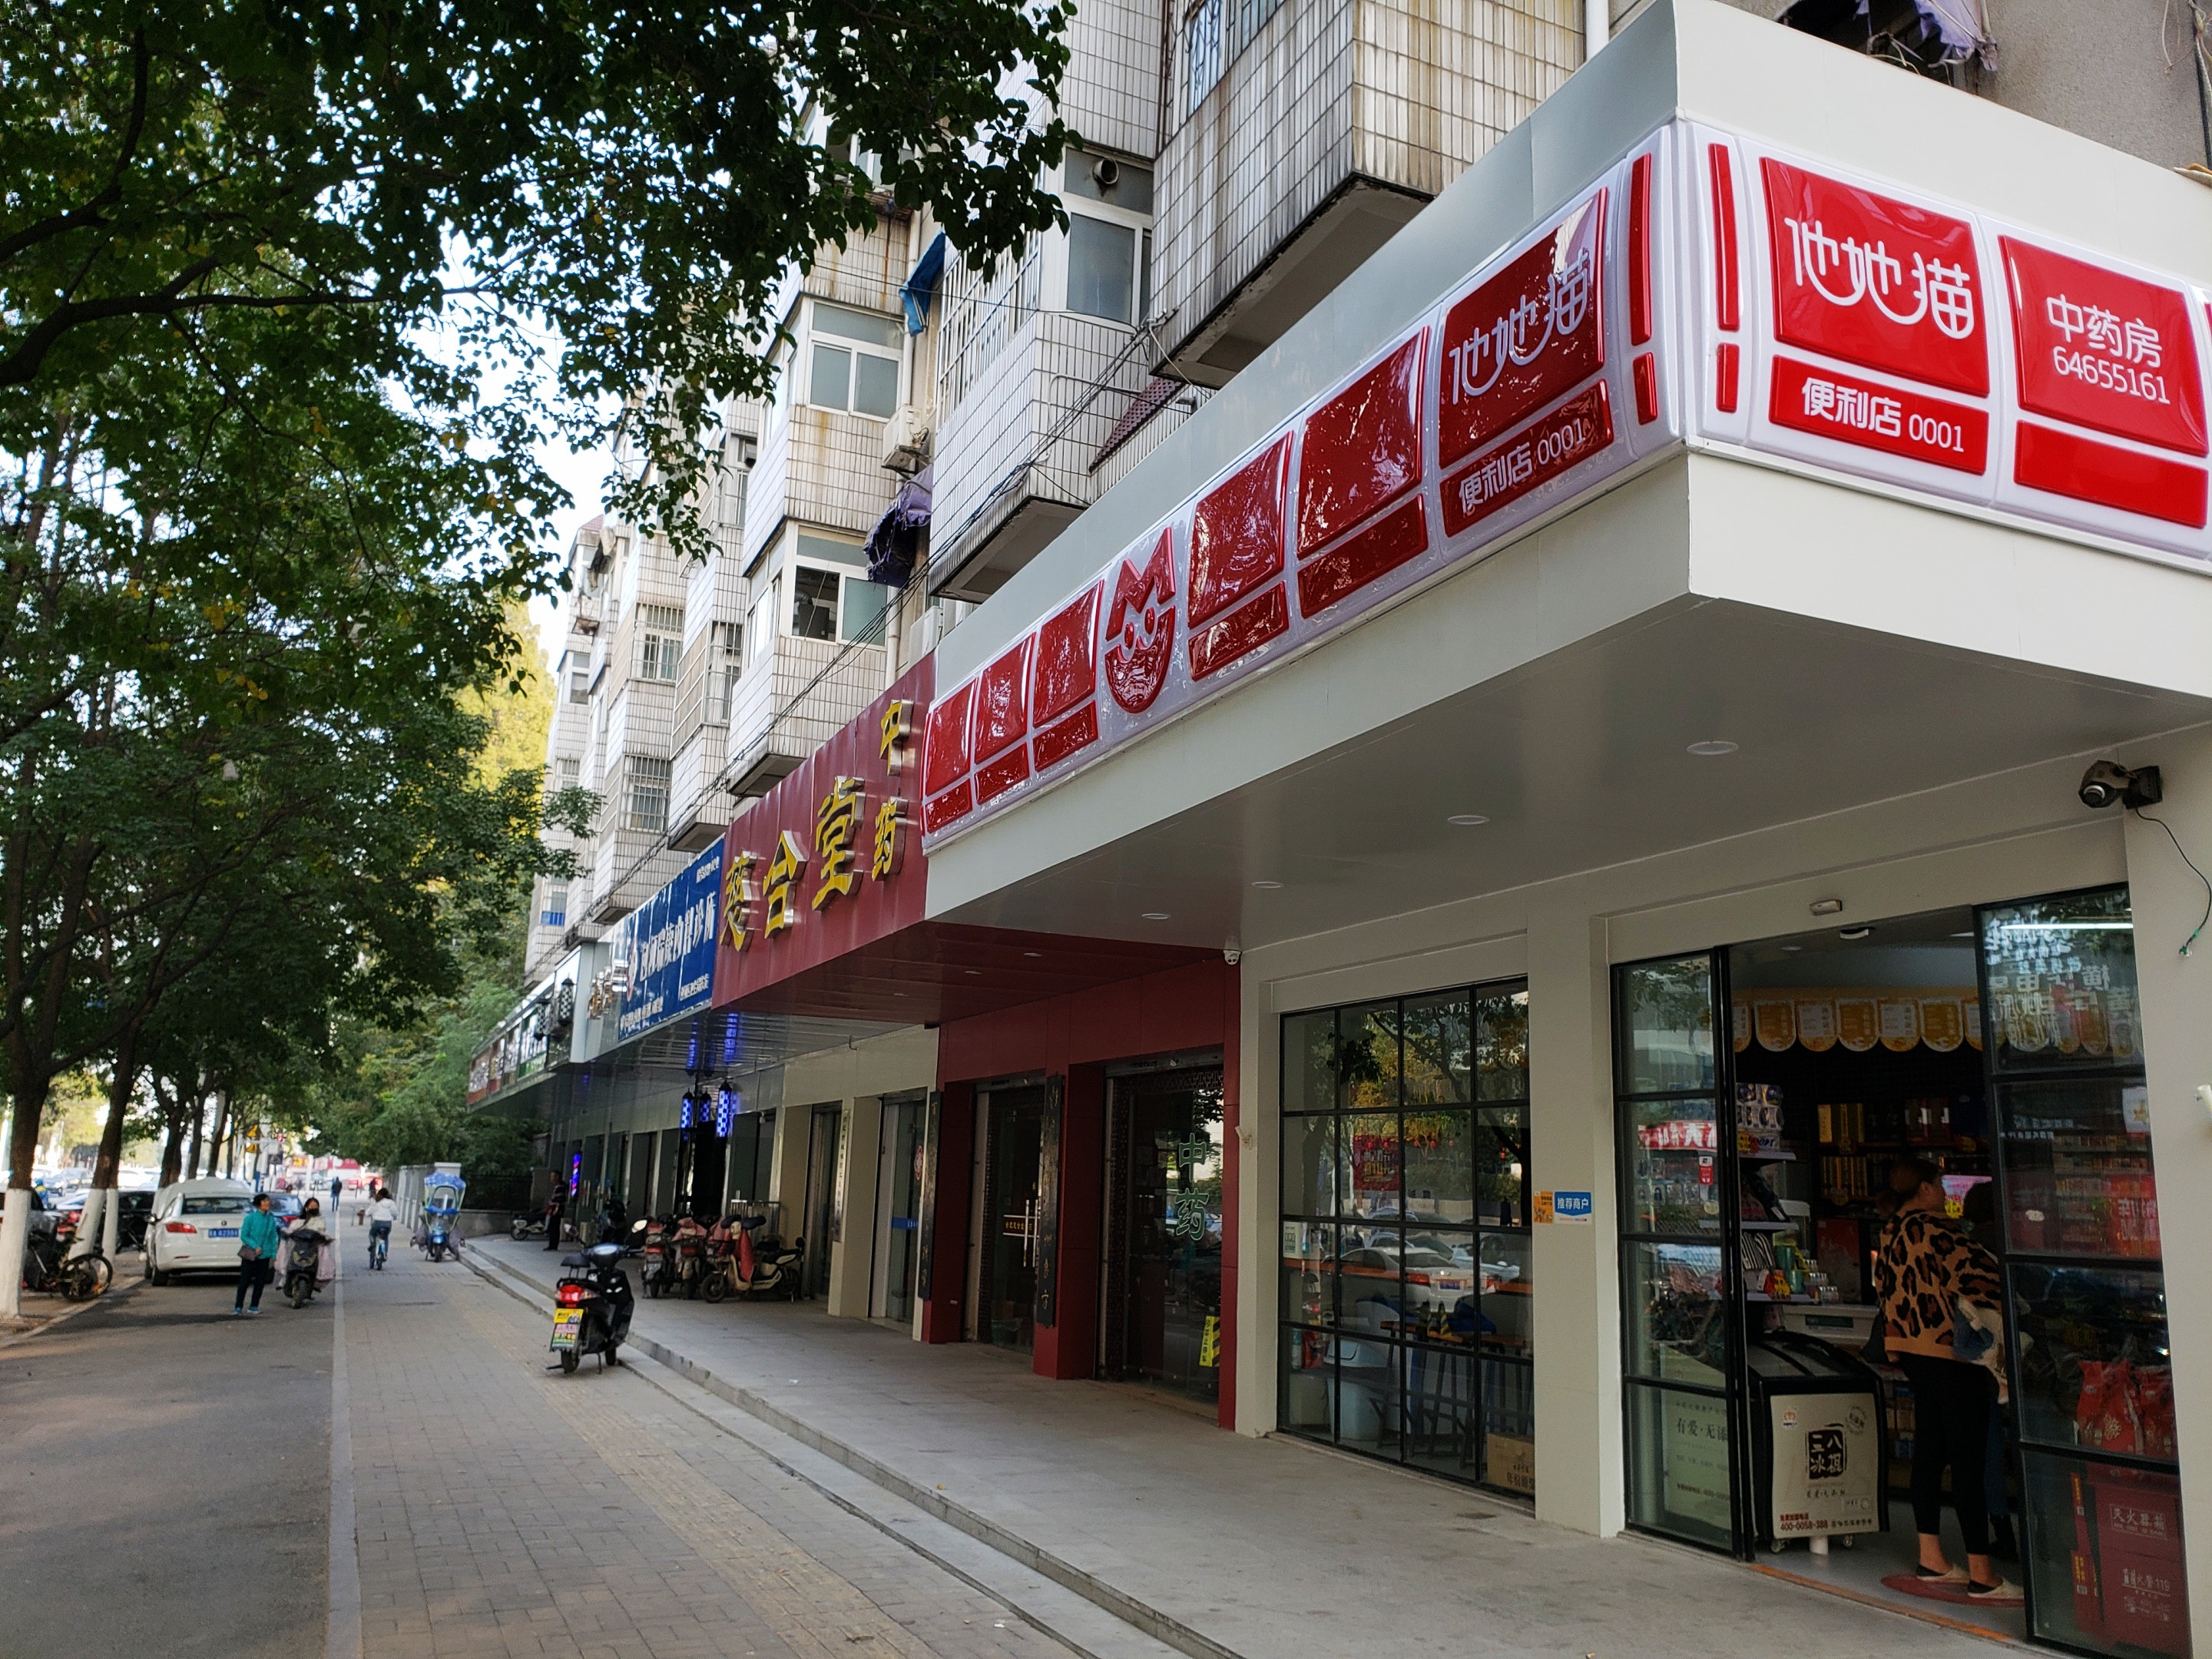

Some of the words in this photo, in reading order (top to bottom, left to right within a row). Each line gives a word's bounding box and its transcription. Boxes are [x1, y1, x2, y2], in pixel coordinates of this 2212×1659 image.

[2046, 294, 2164, 369] 中药房
[2053, 346, 2171, 406] 64655161
[1801, 376, 1902, 438] 便利店
[1909, 412, 1965, 453] 0001
[1459, 442, 1532, 519] 便利店
[1537, 419, 1587, 465] 0001
[1175, 1132, 1210, 1242] 中药
[1557, 1197, 1589, 1210] 推荐商户
